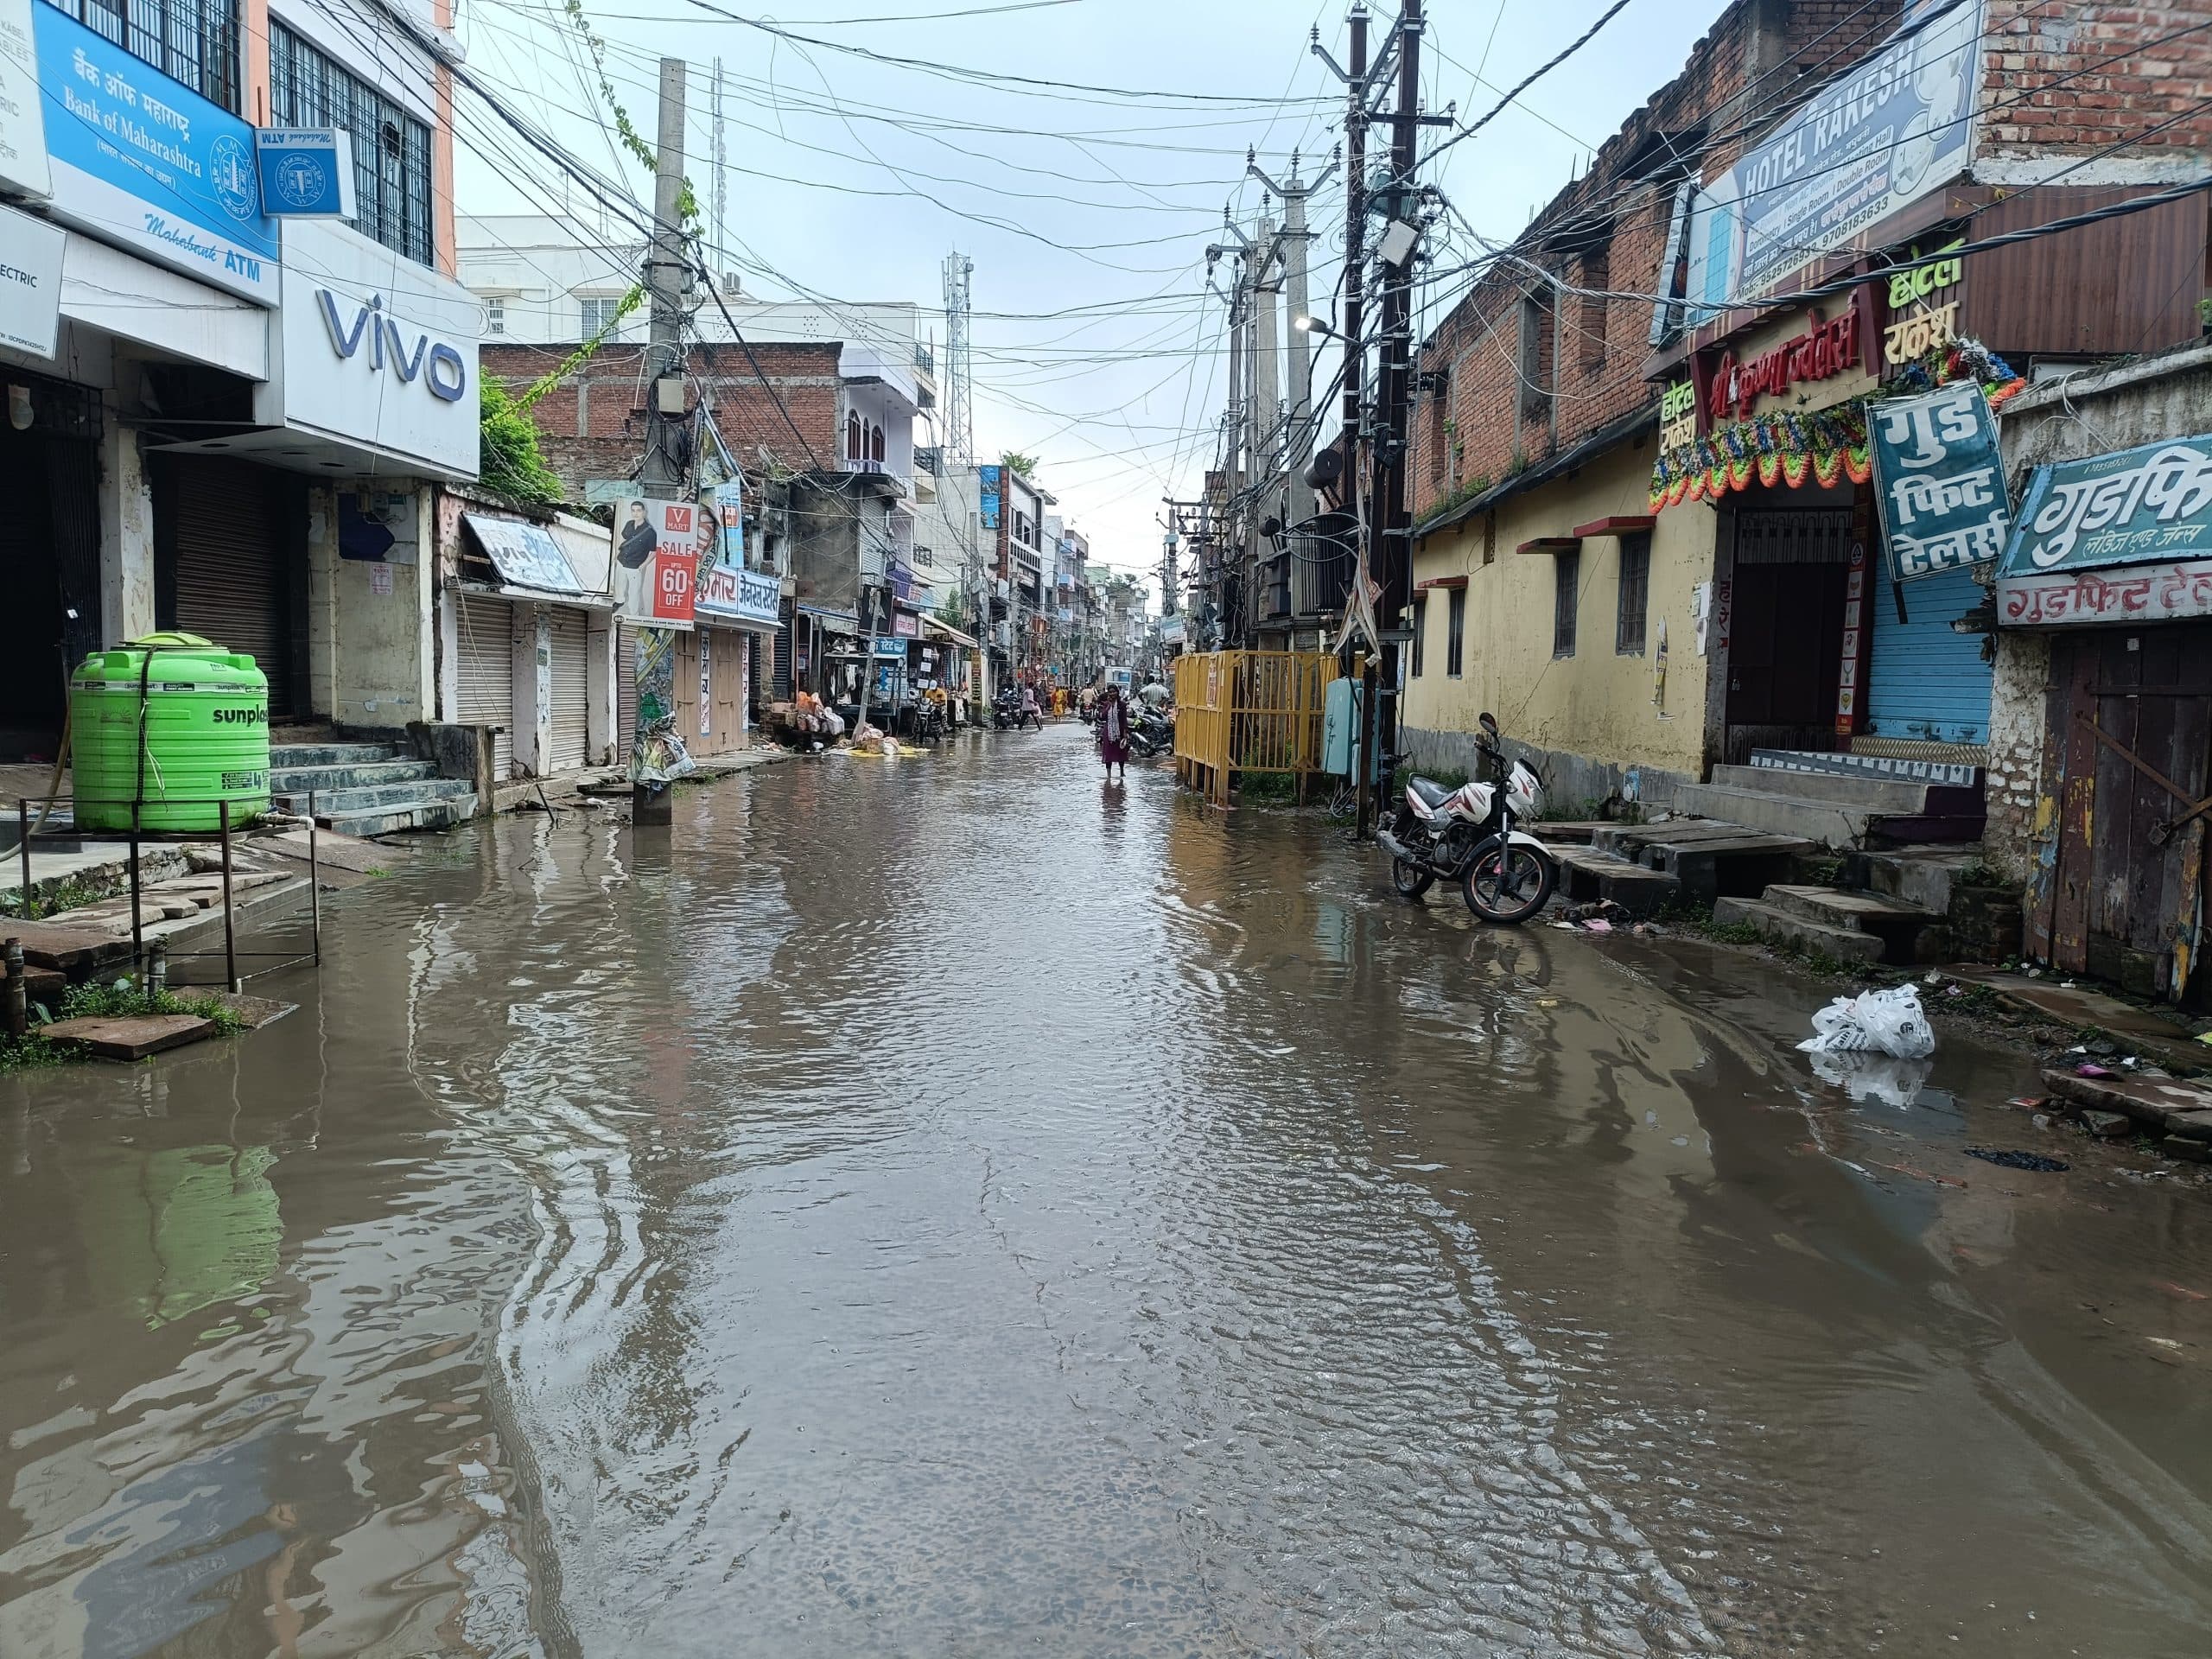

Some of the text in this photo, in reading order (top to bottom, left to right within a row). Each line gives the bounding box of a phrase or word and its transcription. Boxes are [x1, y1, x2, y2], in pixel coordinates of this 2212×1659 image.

[72, 47, 191, 144] बैंक ऑफ महाराष्ट्र
[1743, 38, 1916, 209] HOTEL RAKESH
[63, 85, 102, 126] Bank
[104, 111, 118, 135] of
[121, 114, 202, 178] Maharashtra
[262, 132, 285, 144] ATM
[1874, 128, 1892, 151] Hall
[1787, 206, 1808, 227] Single
[1809, 190, 1829, 212] Room
[1837, 168, 1864, 194] Double
[1865, 149, 1890, 173] Room
[144, 213, 261, 283] Mahabank ATM
[1821, 195, 1890, 248] 9708183633
[1888, 237, 1967, 310] होटल
[1885, 300, 1961, 365] राकेश
[1709, 349, 1738, 419] श्री
[1877, 387, 1980, 468] गुड
[666, 522, 690, 532] MART
[672, 508, 686, 523] V
[1890, 467, 1994, 525] फिट
[662, 541, 692, 556] SALE
[1891, 508, 2011, 575] टेलर्स
[665, 594, 683, 607] OFF
